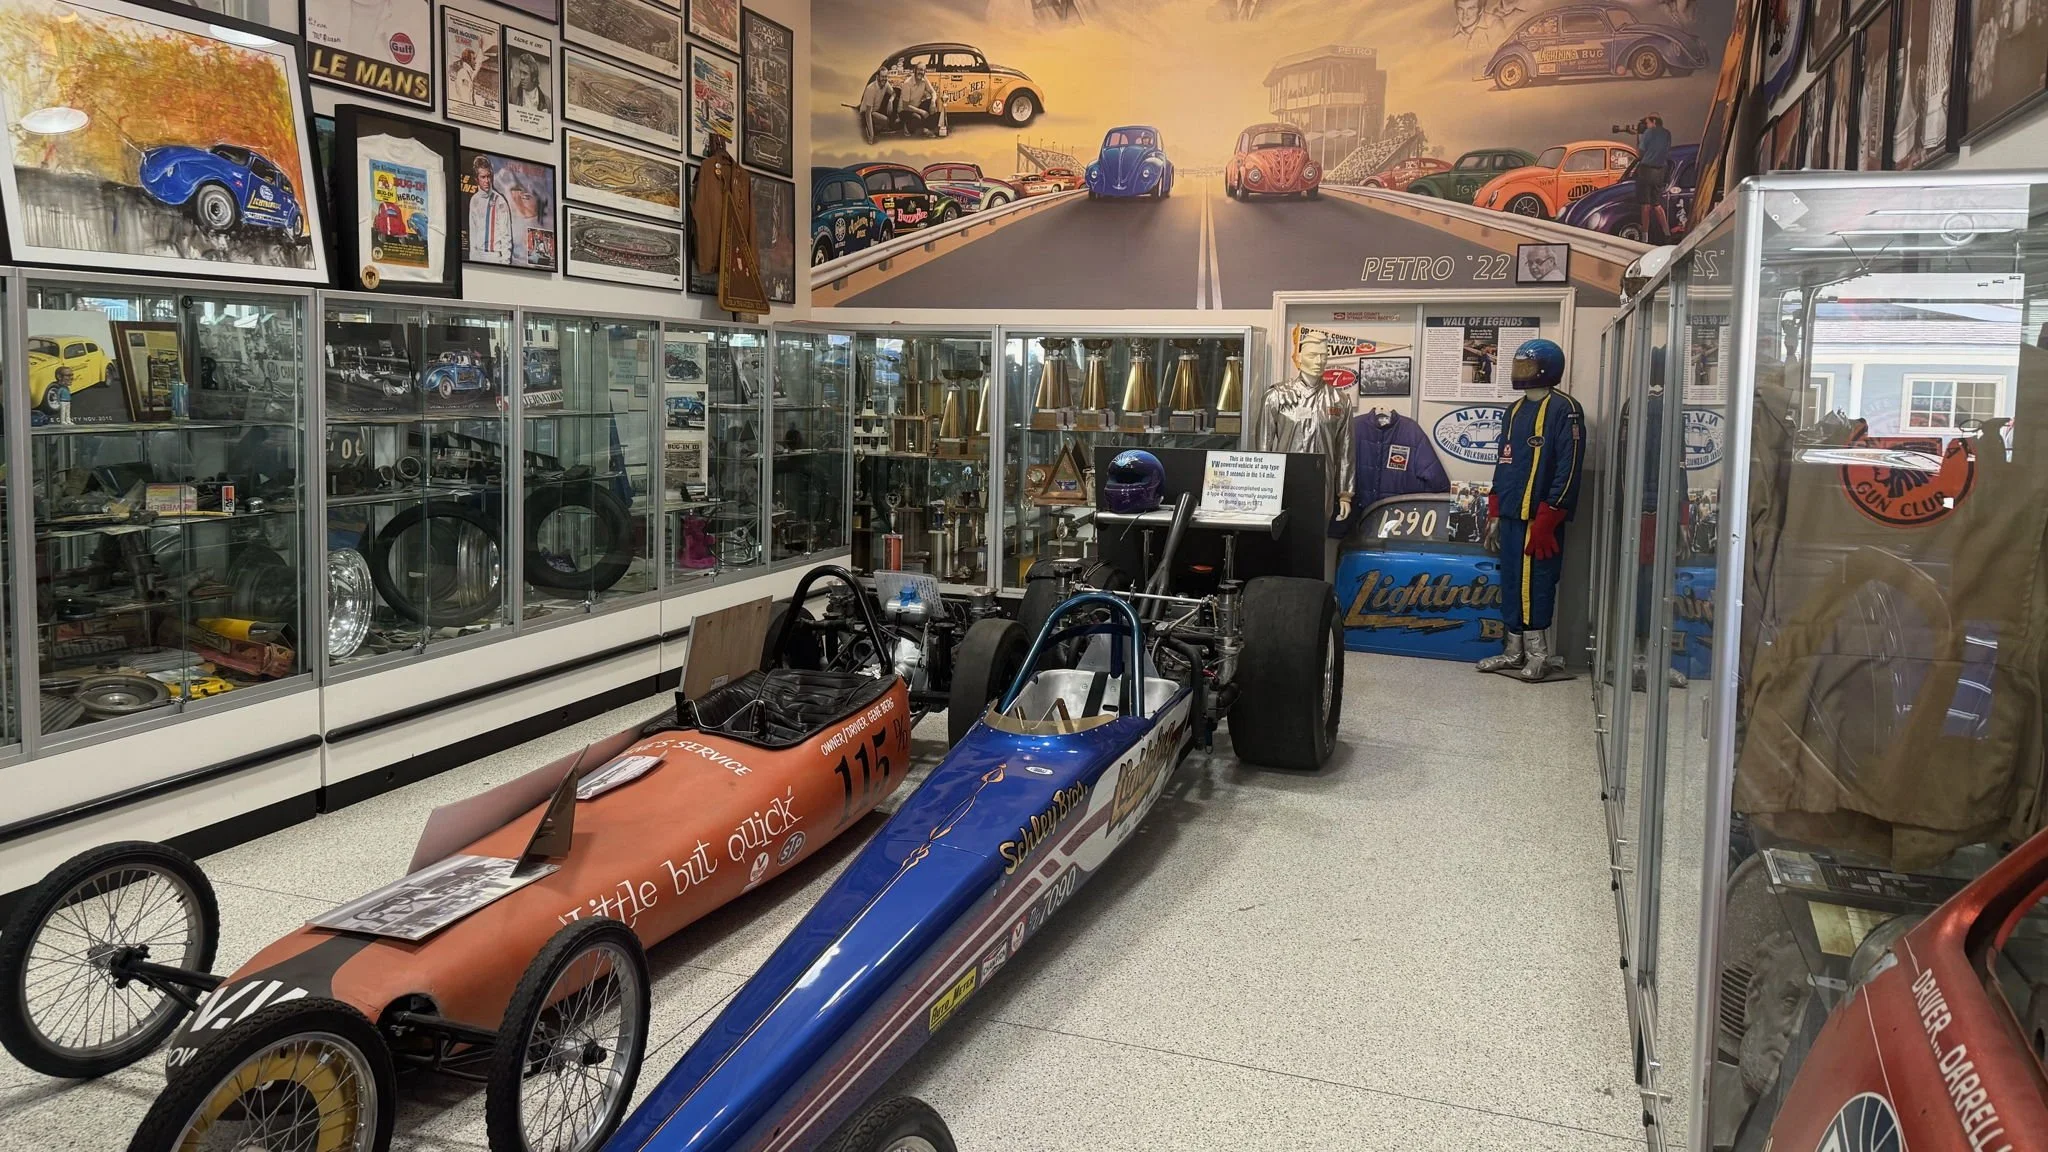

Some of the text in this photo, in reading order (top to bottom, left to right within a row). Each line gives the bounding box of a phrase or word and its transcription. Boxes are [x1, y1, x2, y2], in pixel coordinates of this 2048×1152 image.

[391, 41, 413, 54] Gulf
[1338, 46, 1372, 55] PETRO
[312, 48, 428, 99] LE MANS
[1361, 255, 1456, 281] PETRO
[1442, 317, 1523, 326] WALL OF LEGENDS
[1331, 333, 1356, 342] COUNTY
[1332, 371, 1343, 386] 7
[1441, 437, 1464, 457] NATIONAL
[1856, 481, 1892, 513] GUN
[867, 706, 882, 723] GENE
[881, 697, 895, 716] BERG
[672, 740, 752, 777] SERVICE
[832, 727, 890, 829] 115
[780, 834, 802, 861] STP
[999, 804, 1057, 876] Schley
[660, 839, 718, 896] but
[1938, 1043, 2005, 1152] DARRELL
